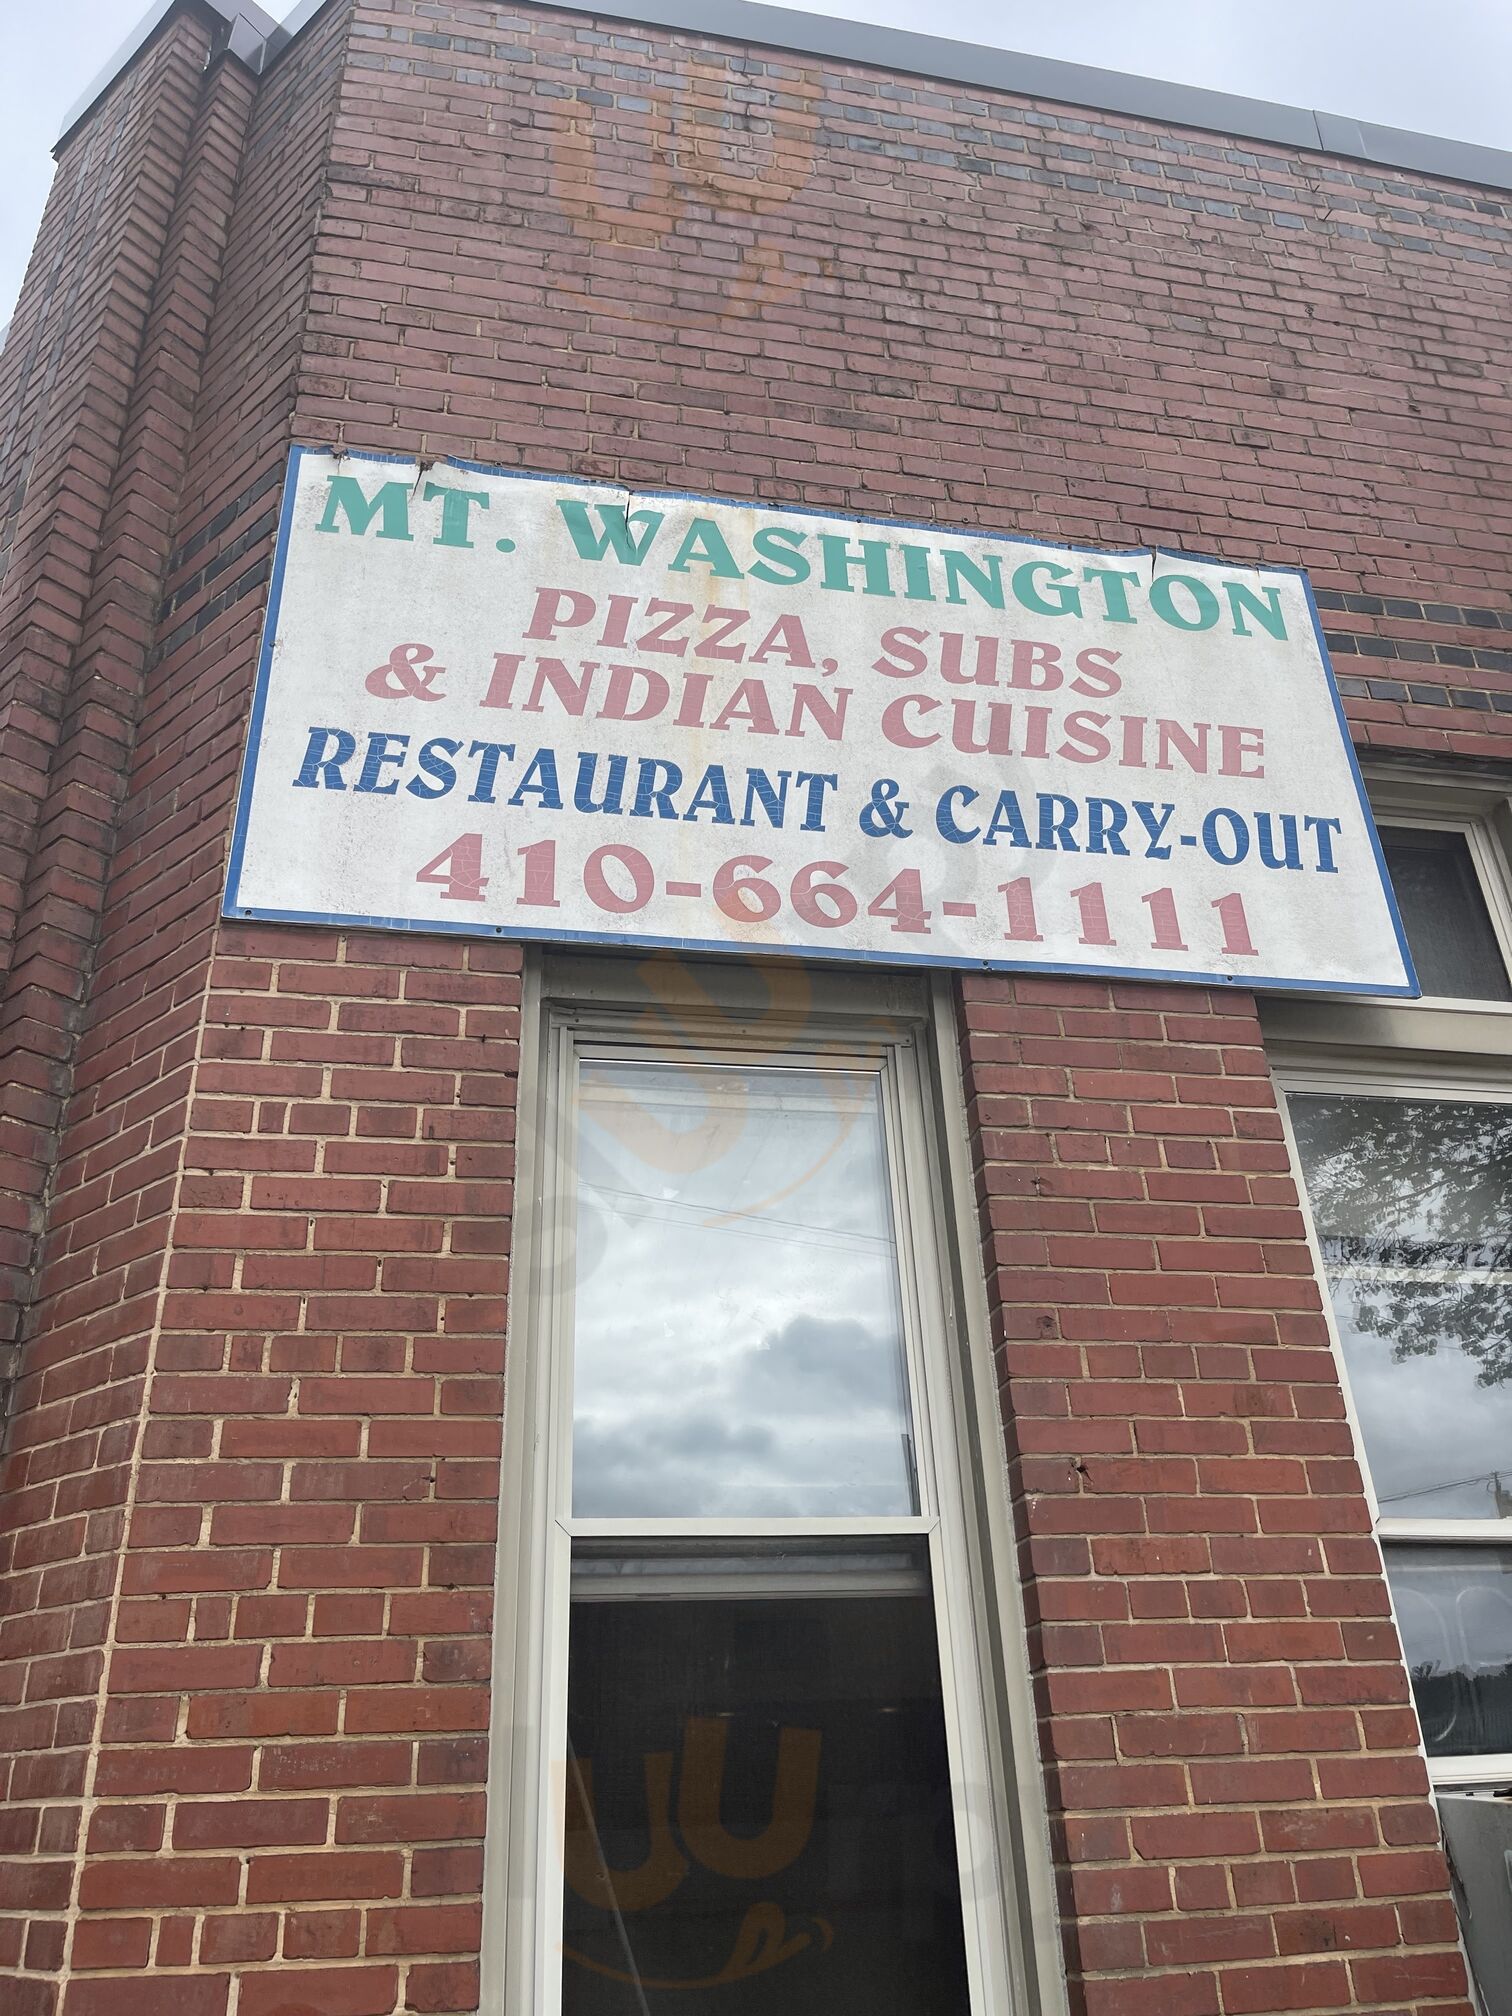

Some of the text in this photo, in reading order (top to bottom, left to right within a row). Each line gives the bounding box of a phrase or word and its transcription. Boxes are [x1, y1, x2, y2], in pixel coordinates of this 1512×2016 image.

[316, 475, 1288, 640] MT. WASHINGTON
[522, 587, 1122, 698] PIZZA, SUBS
[365, 643, 1265, 778] & INDIAN CUISINE
[292, 726, 1342, 873] RESTAURANT & CARRY-OUT
[415, 833, 1258, 956] 410-664-1111
